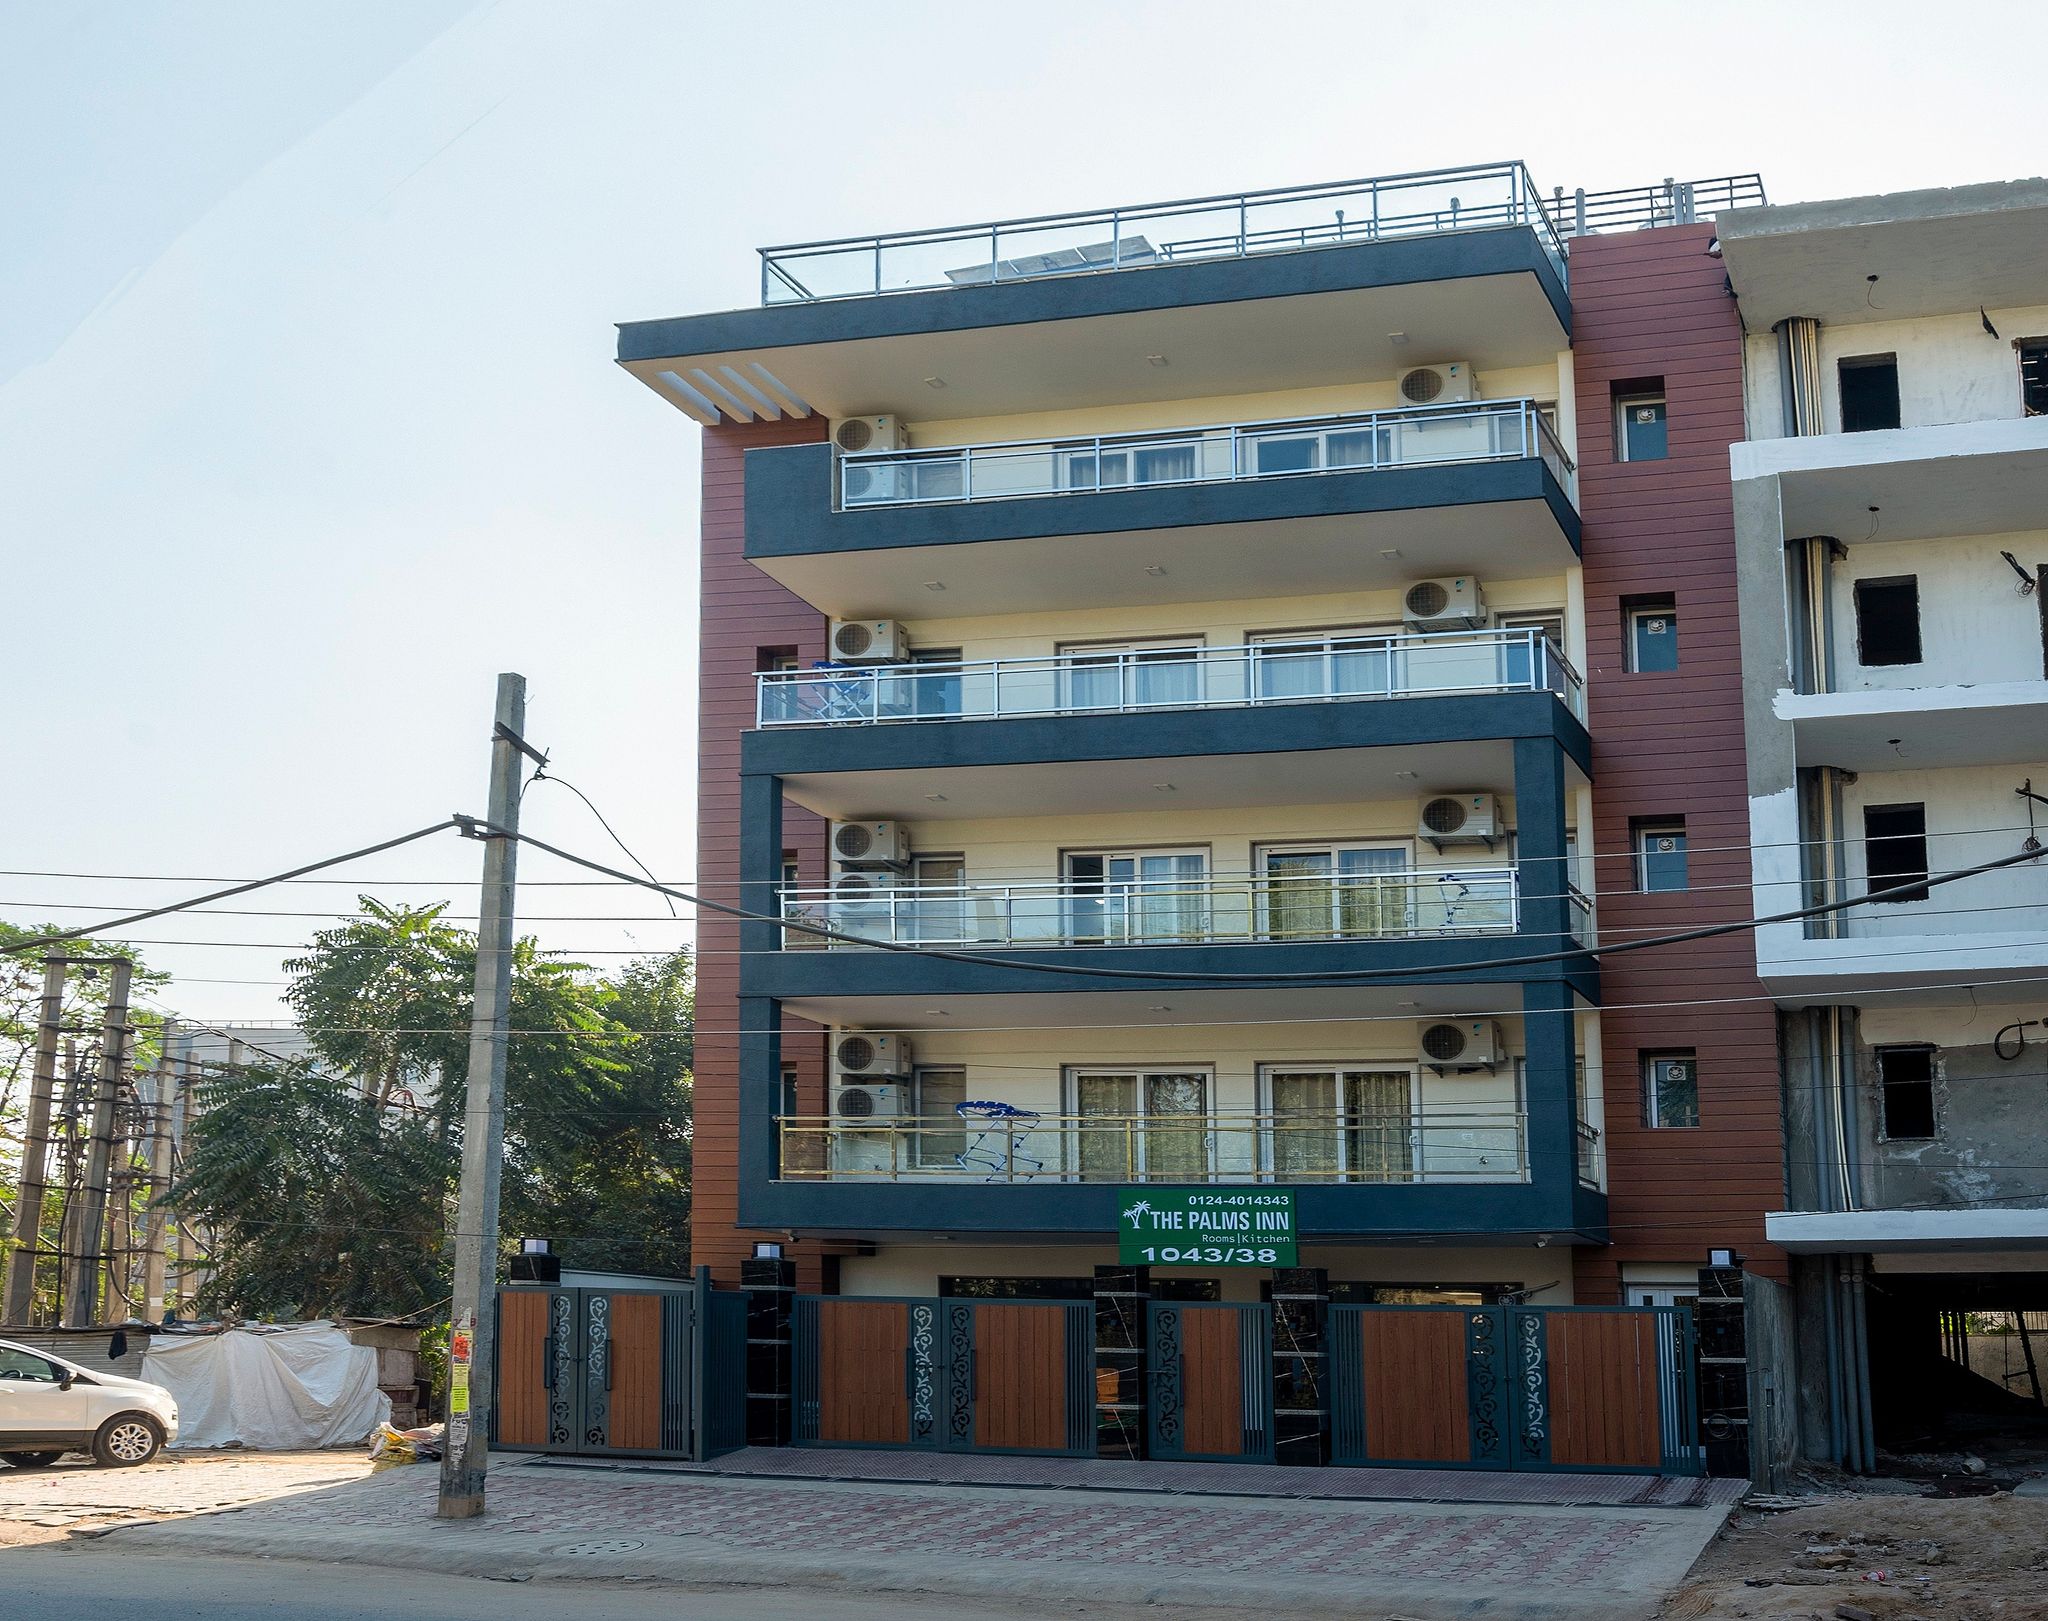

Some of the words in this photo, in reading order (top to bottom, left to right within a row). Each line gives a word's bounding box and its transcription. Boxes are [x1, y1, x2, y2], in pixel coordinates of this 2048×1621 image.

[1188, 1195, 1289, 1205] 0124-4014343
[1149, 1211, 1183, 1230] THE
[1188, 1211, 1250, 1230] PALMS
[1256, 1211, 1289, 1231] INN
[1141, 1247, 1277, 1263] 1043/38
